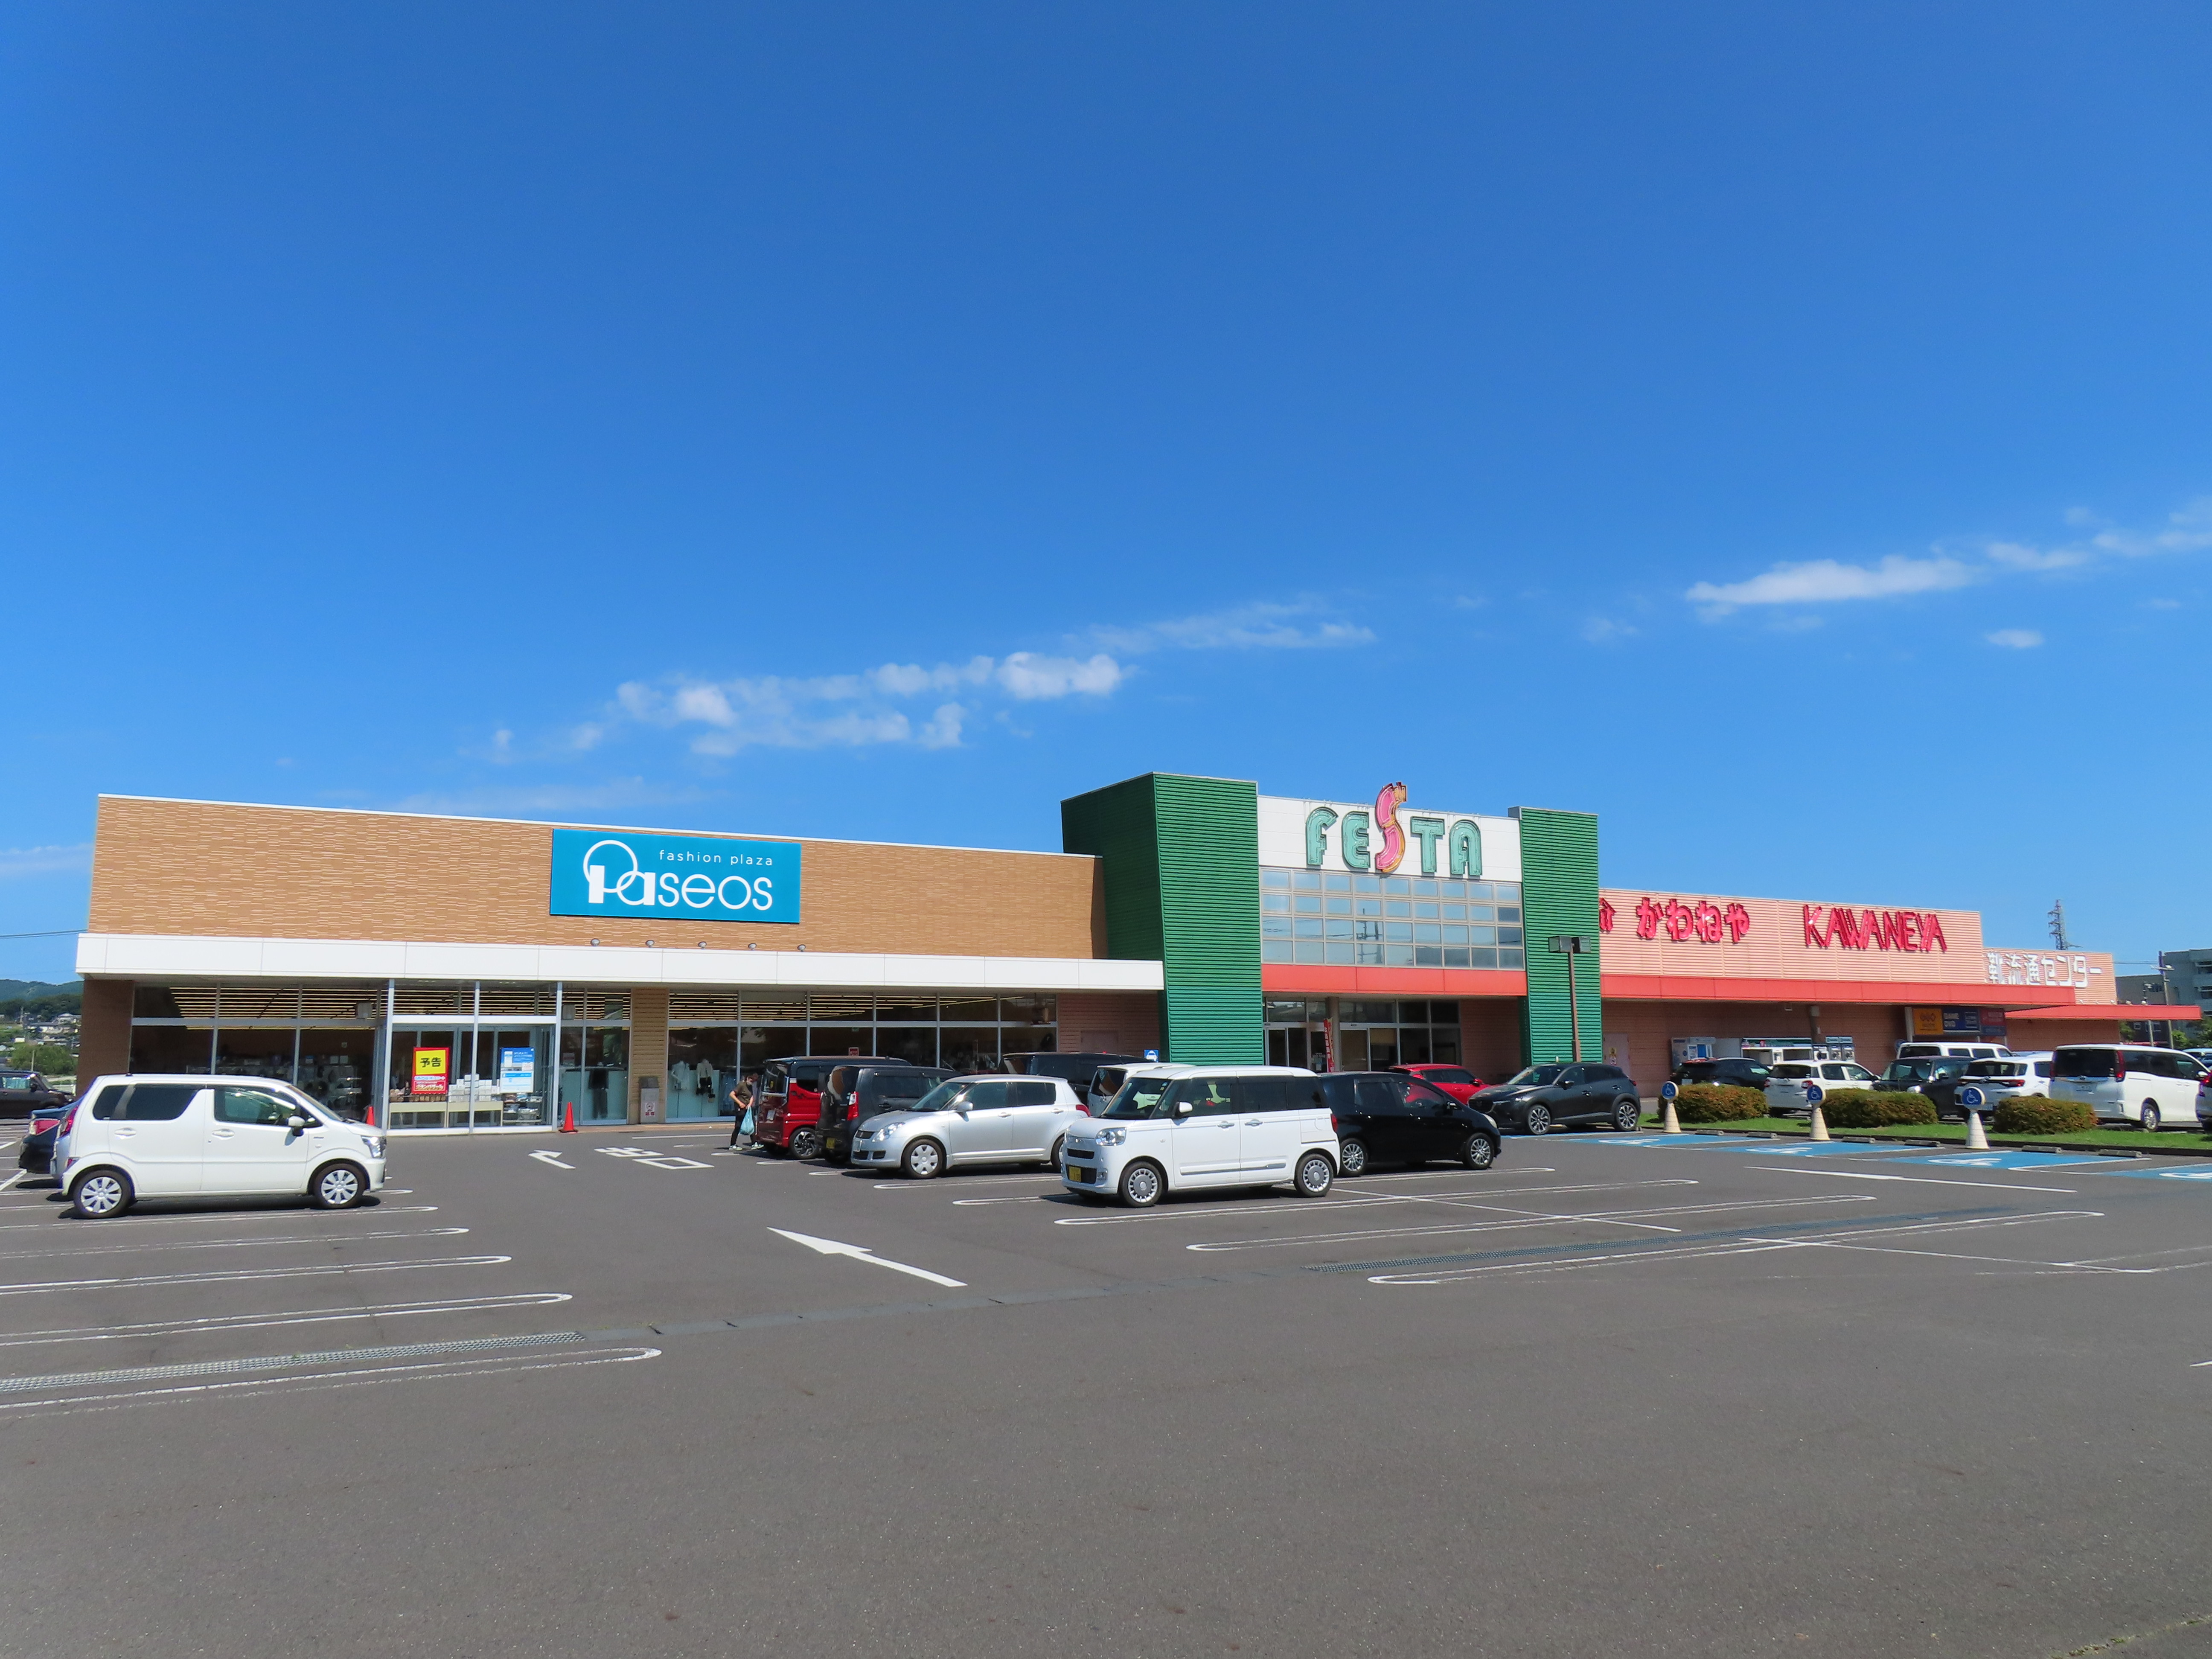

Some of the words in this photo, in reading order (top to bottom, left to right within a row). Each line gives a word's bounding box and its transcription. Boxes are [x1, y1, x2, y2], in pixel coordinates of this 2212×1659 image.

[1305, 781, 1483, 876] FESTA
[659, 850, 721, 863] fashion
[730, 854, 773, 865] plaza
[1636, 896, 1750, 944] かわねや
[1803, 904, 1947, 952] KAWANEYA
[420, 1057, 442, 1068] 予告
